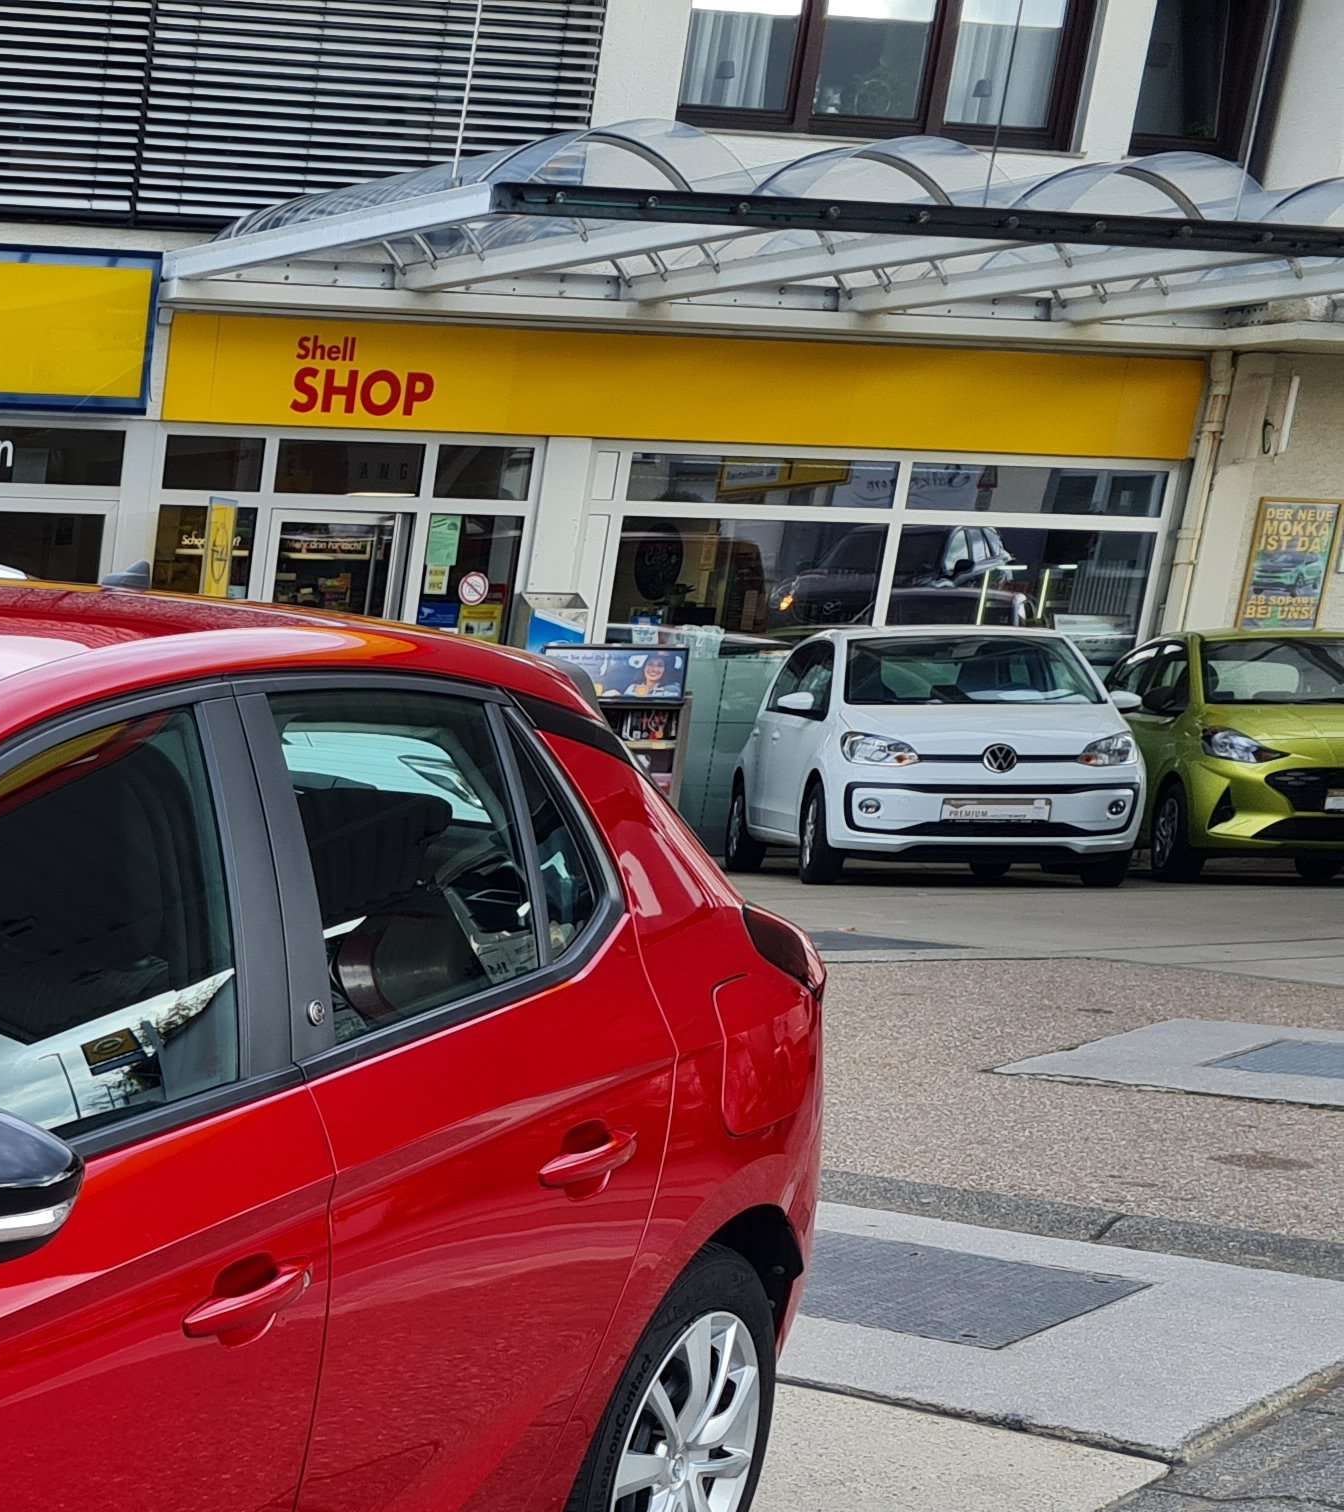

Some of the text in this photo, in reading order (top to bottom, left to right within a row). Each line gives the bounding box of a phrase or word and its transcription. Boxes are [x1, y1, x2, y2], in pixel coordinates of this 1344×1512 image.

[296, 335, 357, 362] Shell
[289, 366, 435, 417] SHOP
[1266, 508, 1333, 522] DER NEUE
[1263, 520, 1330, 537] MOKKA
[1259, 535, 1291, 551] IST
